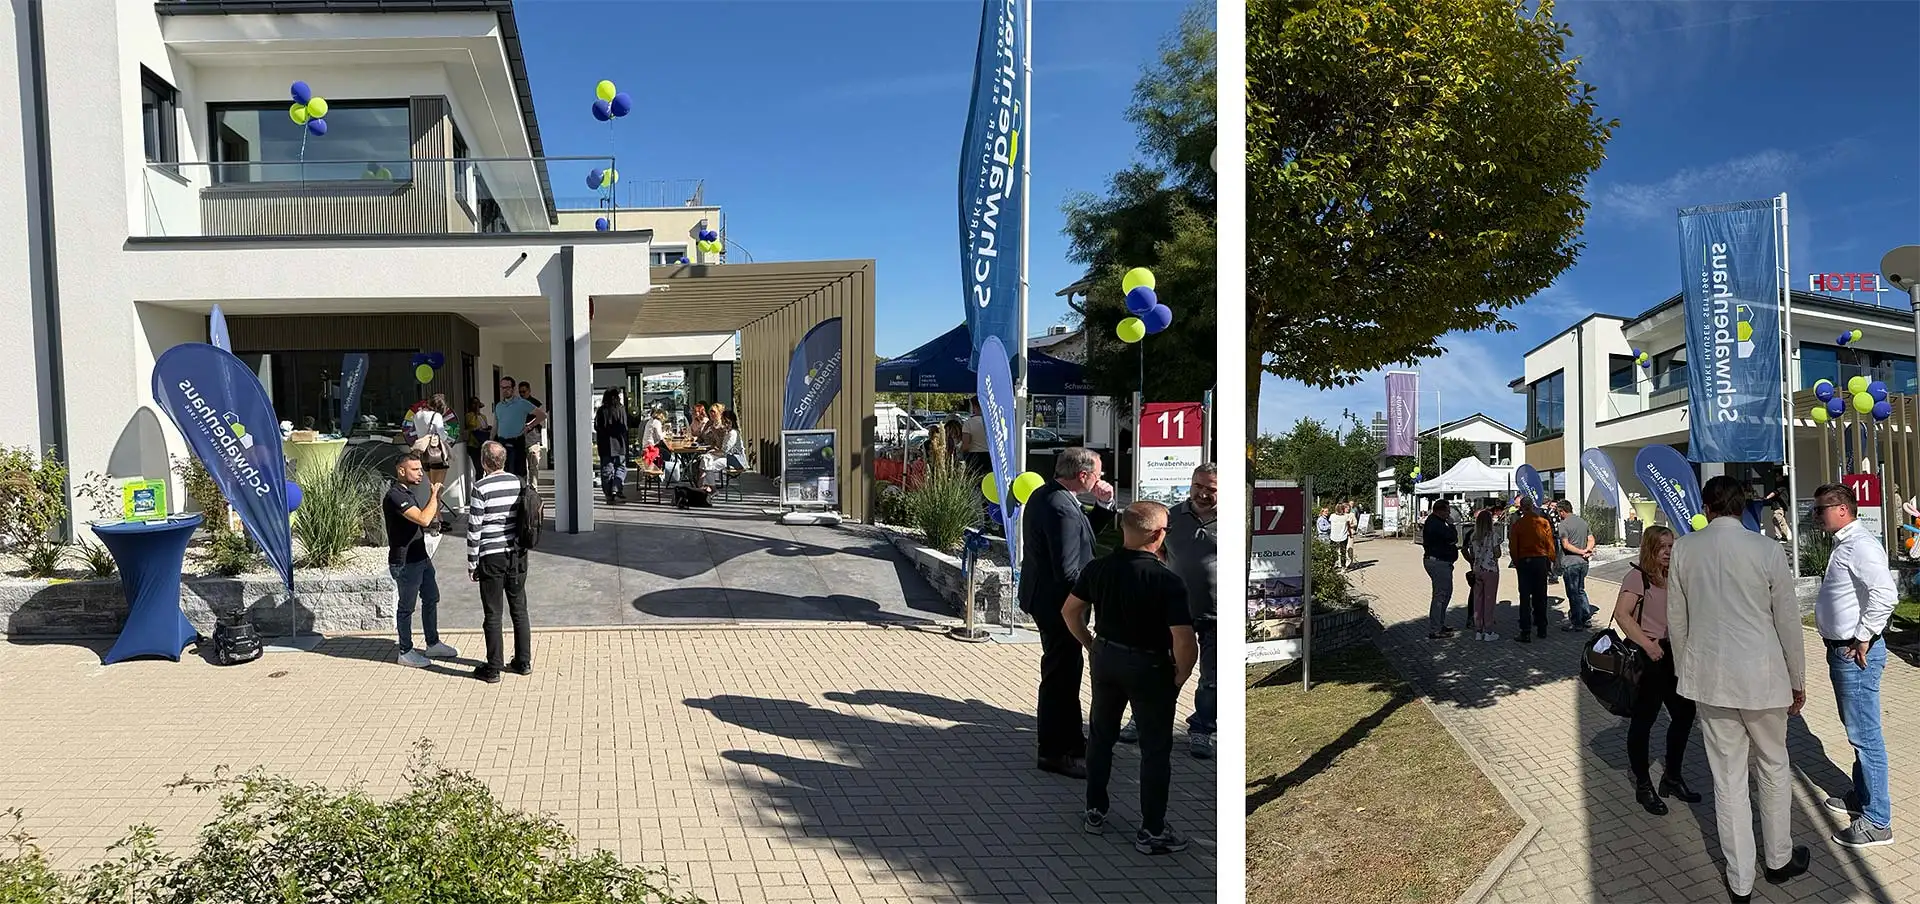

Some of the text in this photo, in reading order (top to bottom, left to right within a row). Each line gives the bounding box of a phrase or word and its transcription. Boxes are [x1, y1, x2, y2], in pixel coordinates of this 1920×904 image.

[1809, 272, 1889, 292] HOTEL
[793, 348, 842, 416] Schwabenha
[1157, 410, 1184, 439] 11
[1147, 460, 1196, 468] Schwabenhaus
[1853, 479, 1870, 501] 11
[1253, 505, 1285, 531] 17
